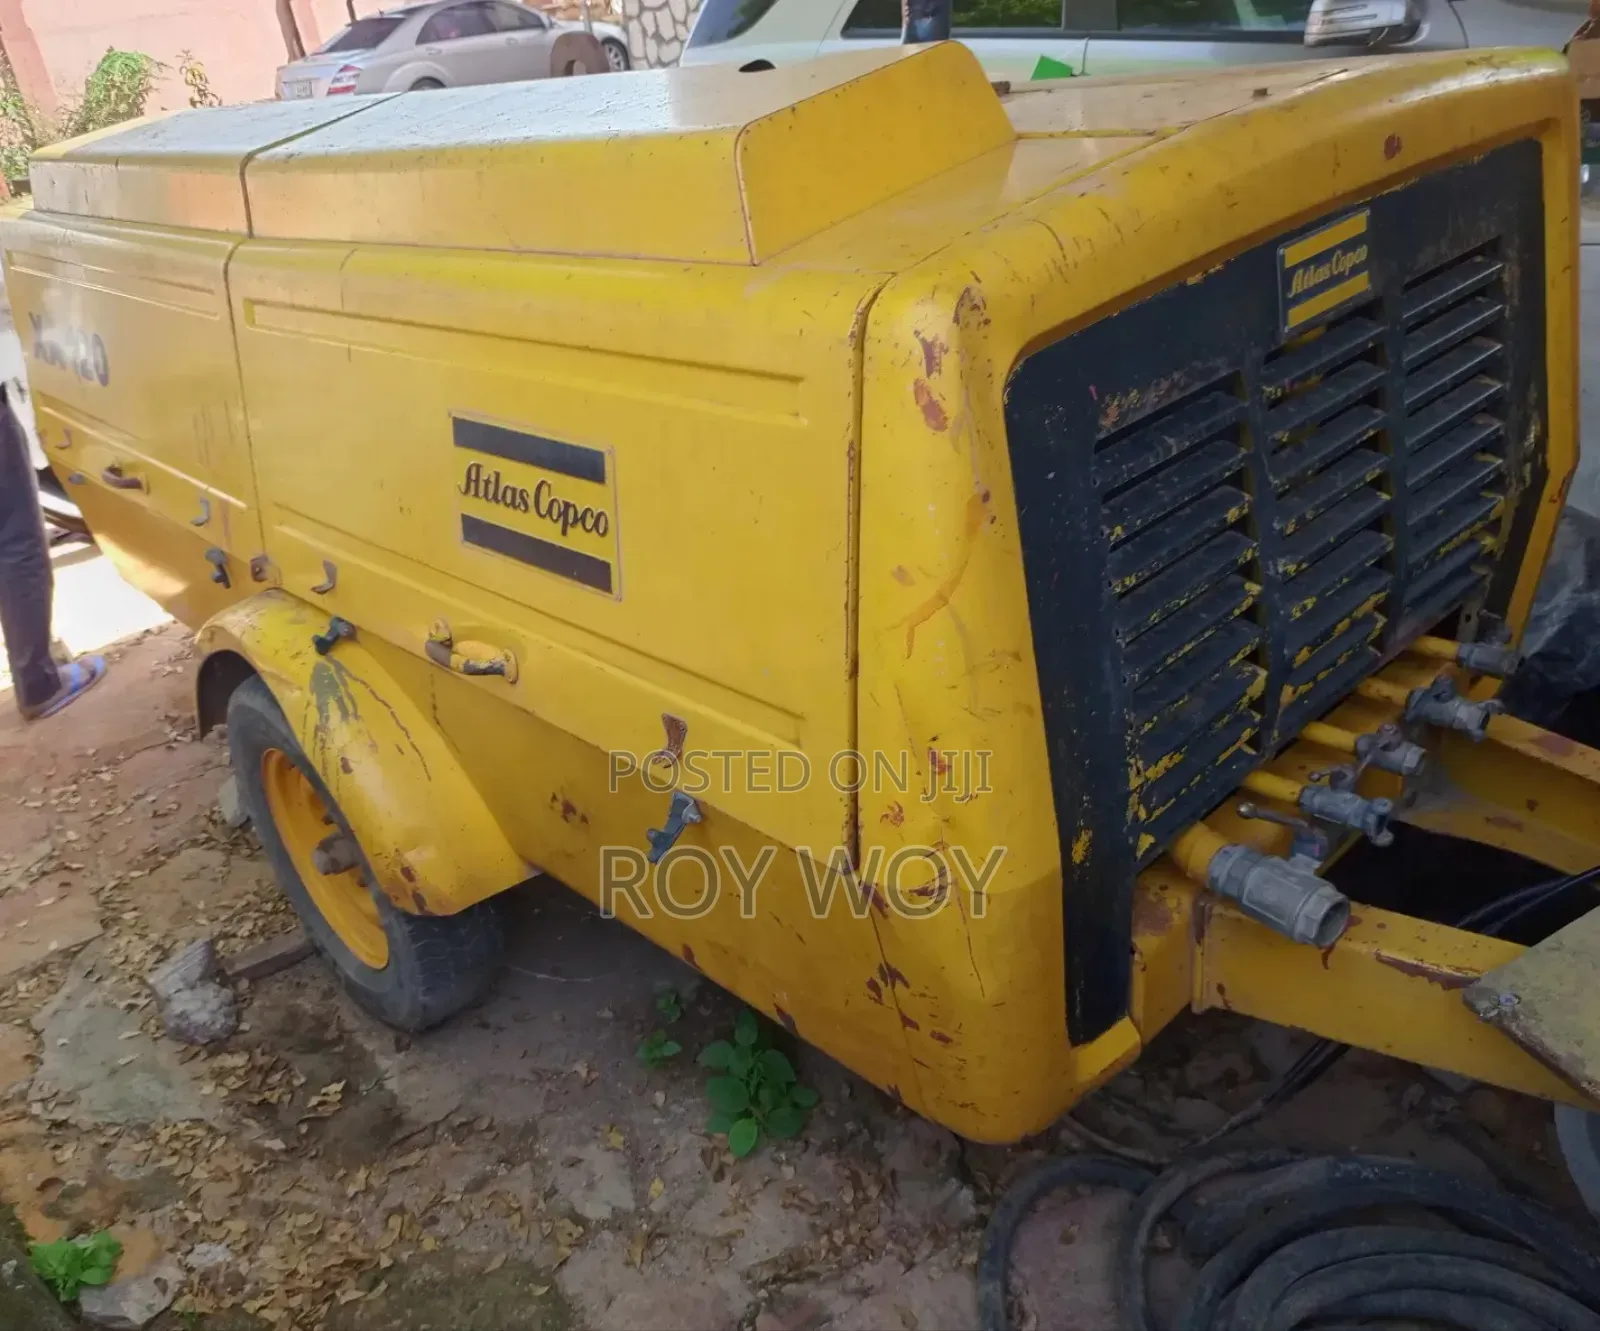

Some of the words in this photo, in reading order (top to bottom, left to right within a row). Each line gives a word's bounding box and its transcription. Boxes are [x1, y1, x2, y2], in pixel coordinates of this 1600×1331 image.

[1287, 263, 1331, 298] Atlas
[1331, 244, 1368, 276] Copco
[458, 462, 530, 514] Atlas
[534, 479, 609, 538] Copco
